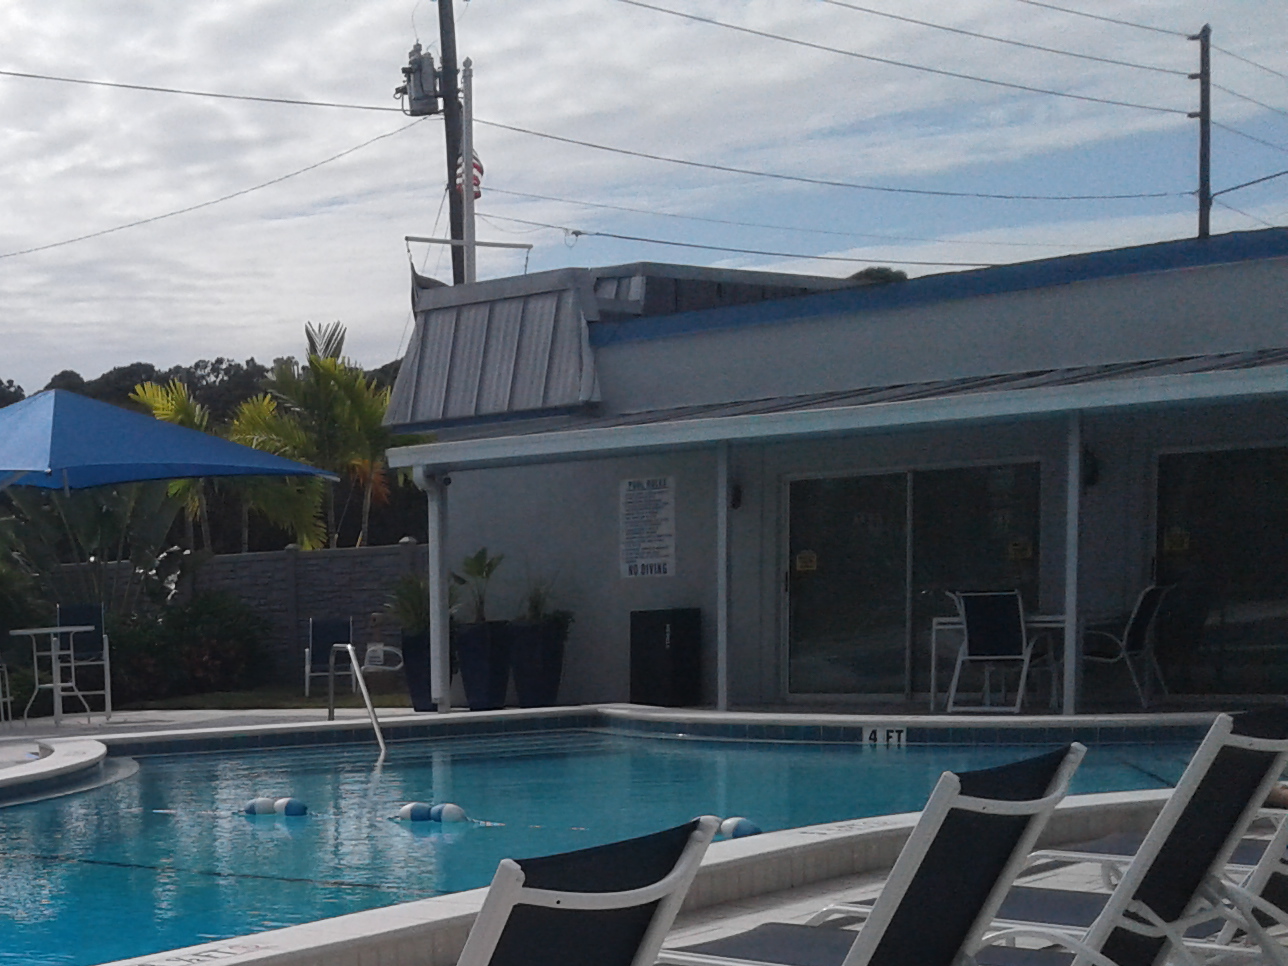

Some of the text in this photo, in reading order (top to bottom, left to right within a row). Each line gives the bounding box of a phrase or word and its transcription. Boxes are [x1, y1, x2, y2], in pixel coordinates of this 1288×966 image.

[628, 562, 668, 576] NO DIVING
[869, 729, 904, 743] 4 FT
